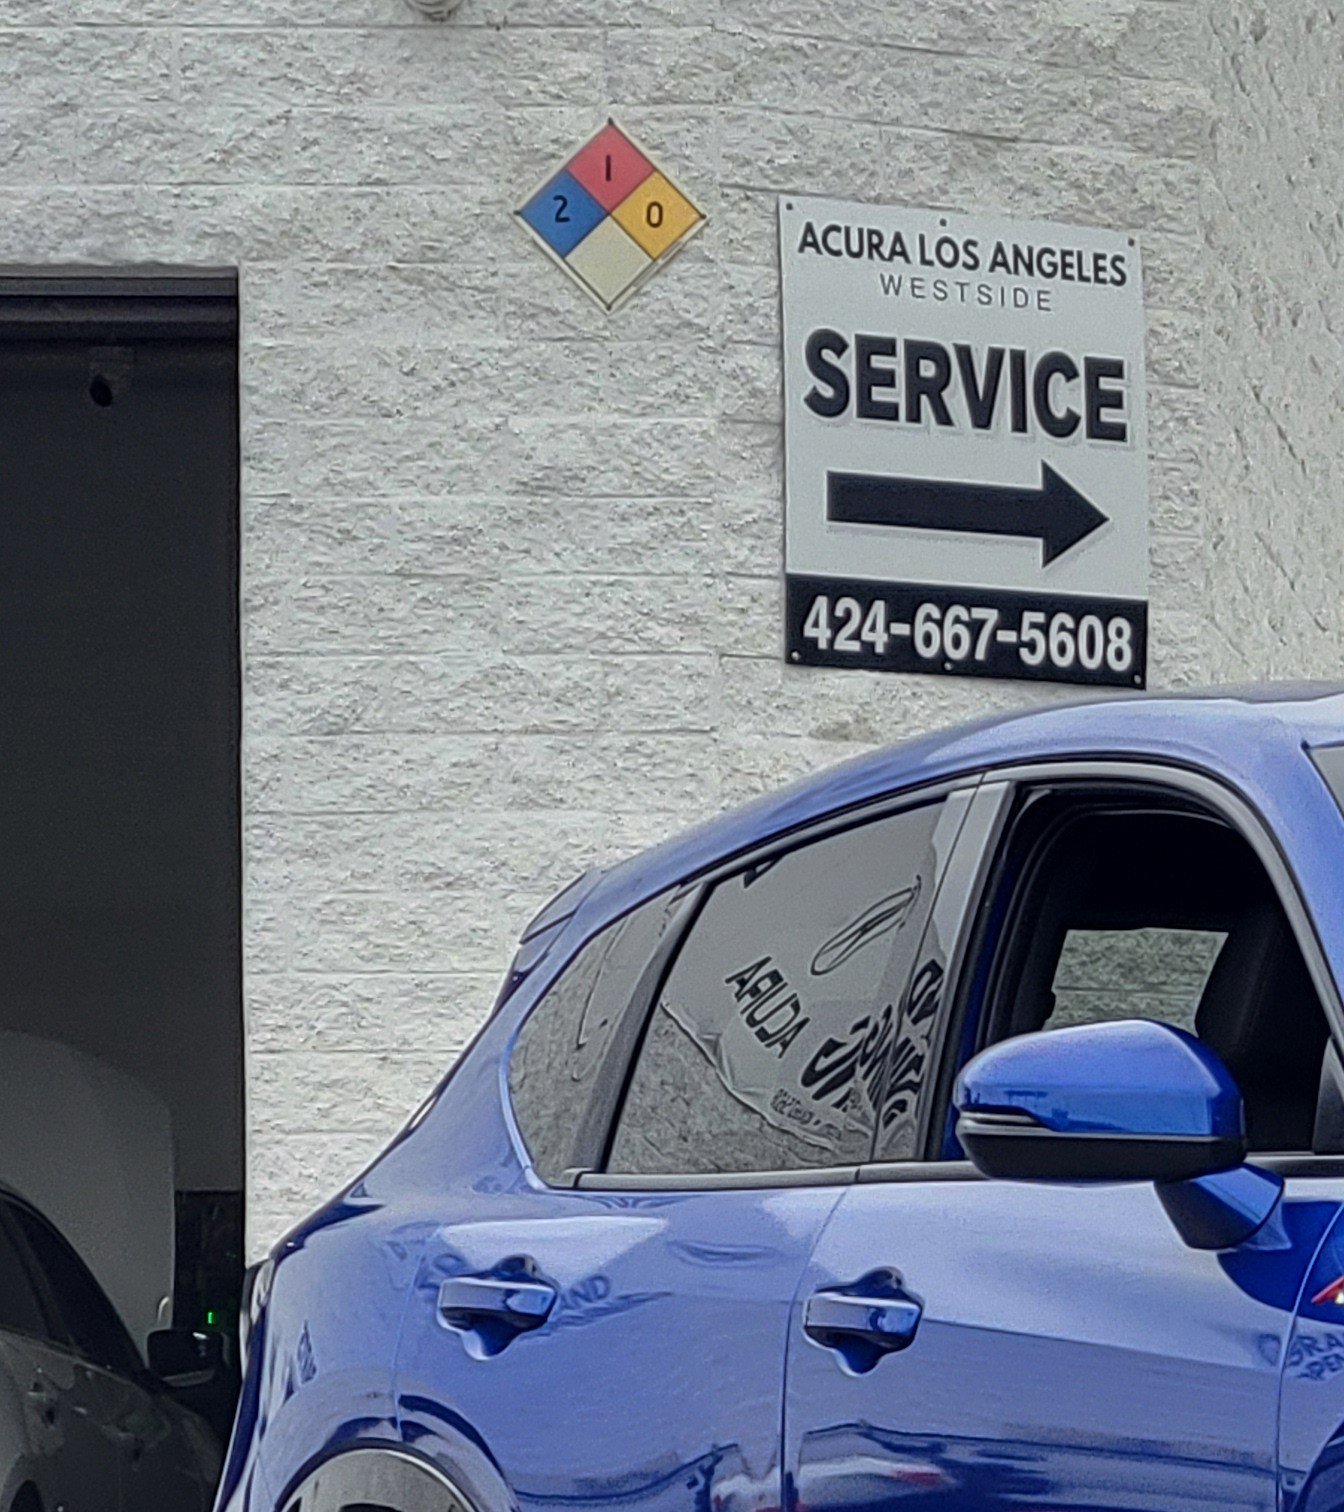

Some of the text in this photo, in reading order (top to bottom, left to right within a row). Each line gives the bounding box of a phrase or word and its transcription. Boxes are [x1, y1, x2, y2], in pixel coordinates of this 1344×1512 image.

[606, 155, 613, 182] 1
[553, 195, 570, 223] 2
[646, 202, 663, 229] 0
[798, 221, 1127, 287] ACURA LOS ANGELES
[880, 275, 1052, 312] WESTSIDE
[803, 328, 1129, 443] SERVICE
[803, 595, 1132, 671] 424-667-5608
